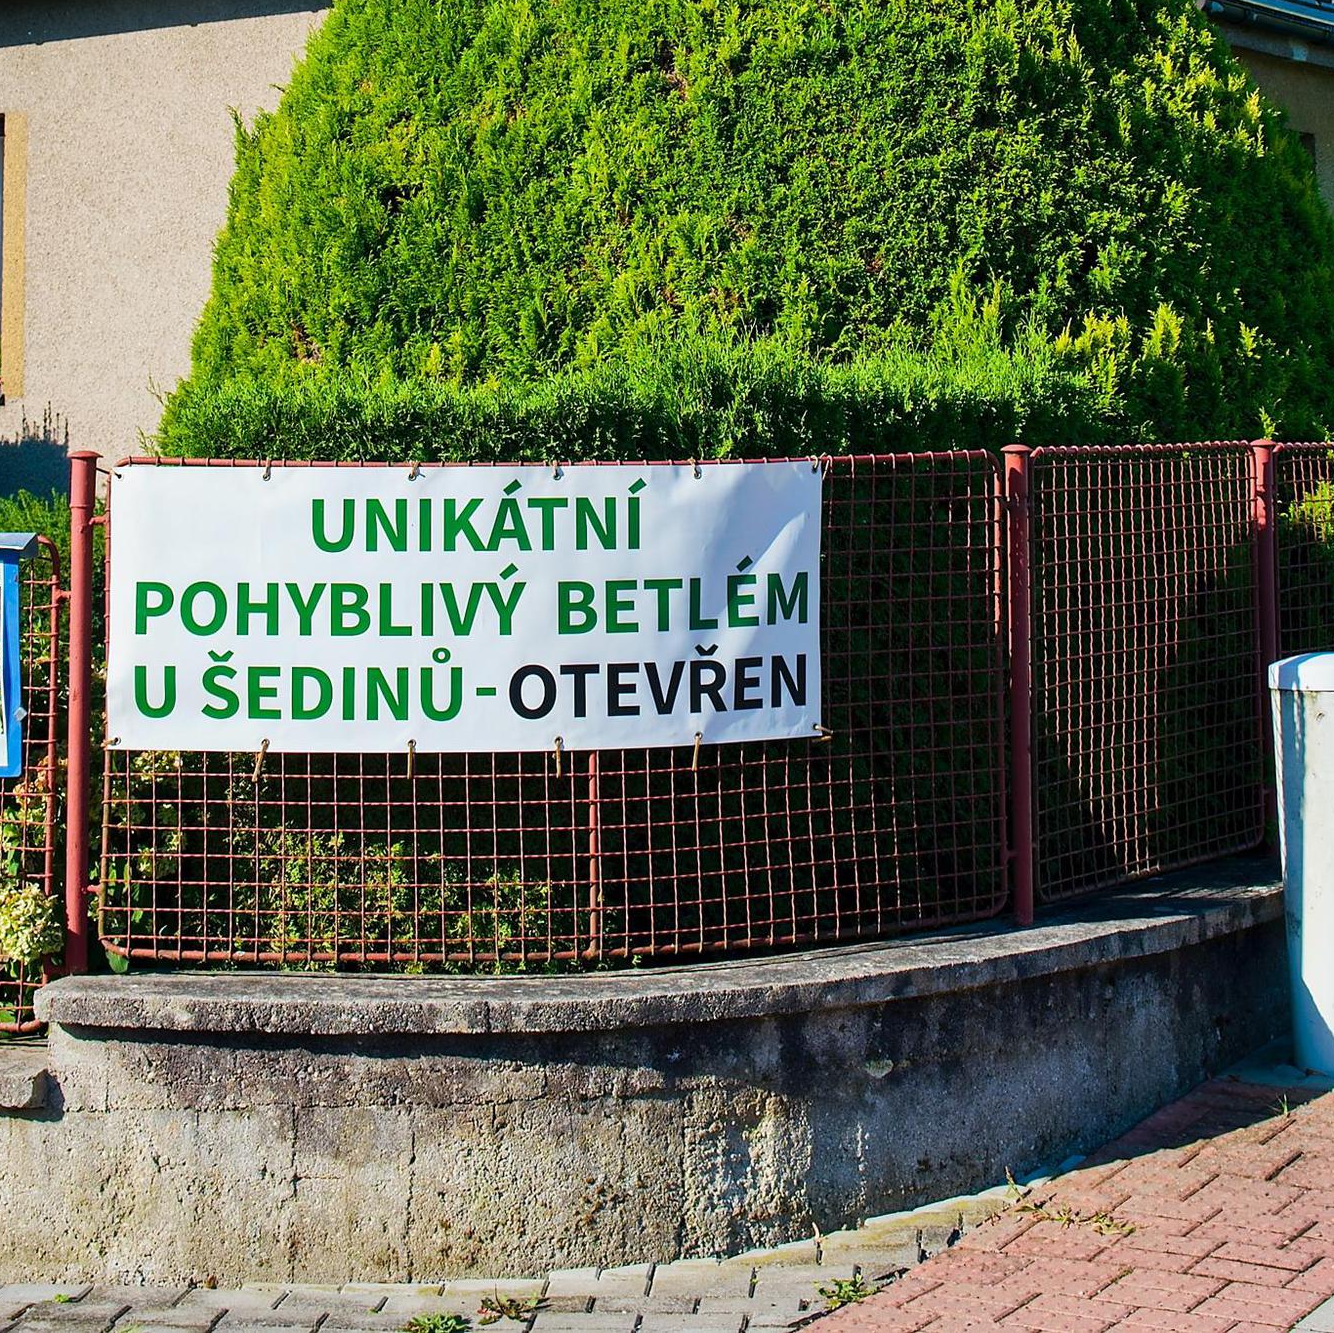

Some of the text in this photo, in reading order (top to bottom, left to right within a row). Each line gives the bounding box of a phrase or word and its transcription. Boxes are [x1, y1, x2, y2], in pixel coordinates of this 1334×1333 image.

[310, 477, 647, 554] UNIKÁTNÍ
[134, 554, 810, 637] POHYBLIVÝ BETLÉM
[133, 665, 178, 720] U
